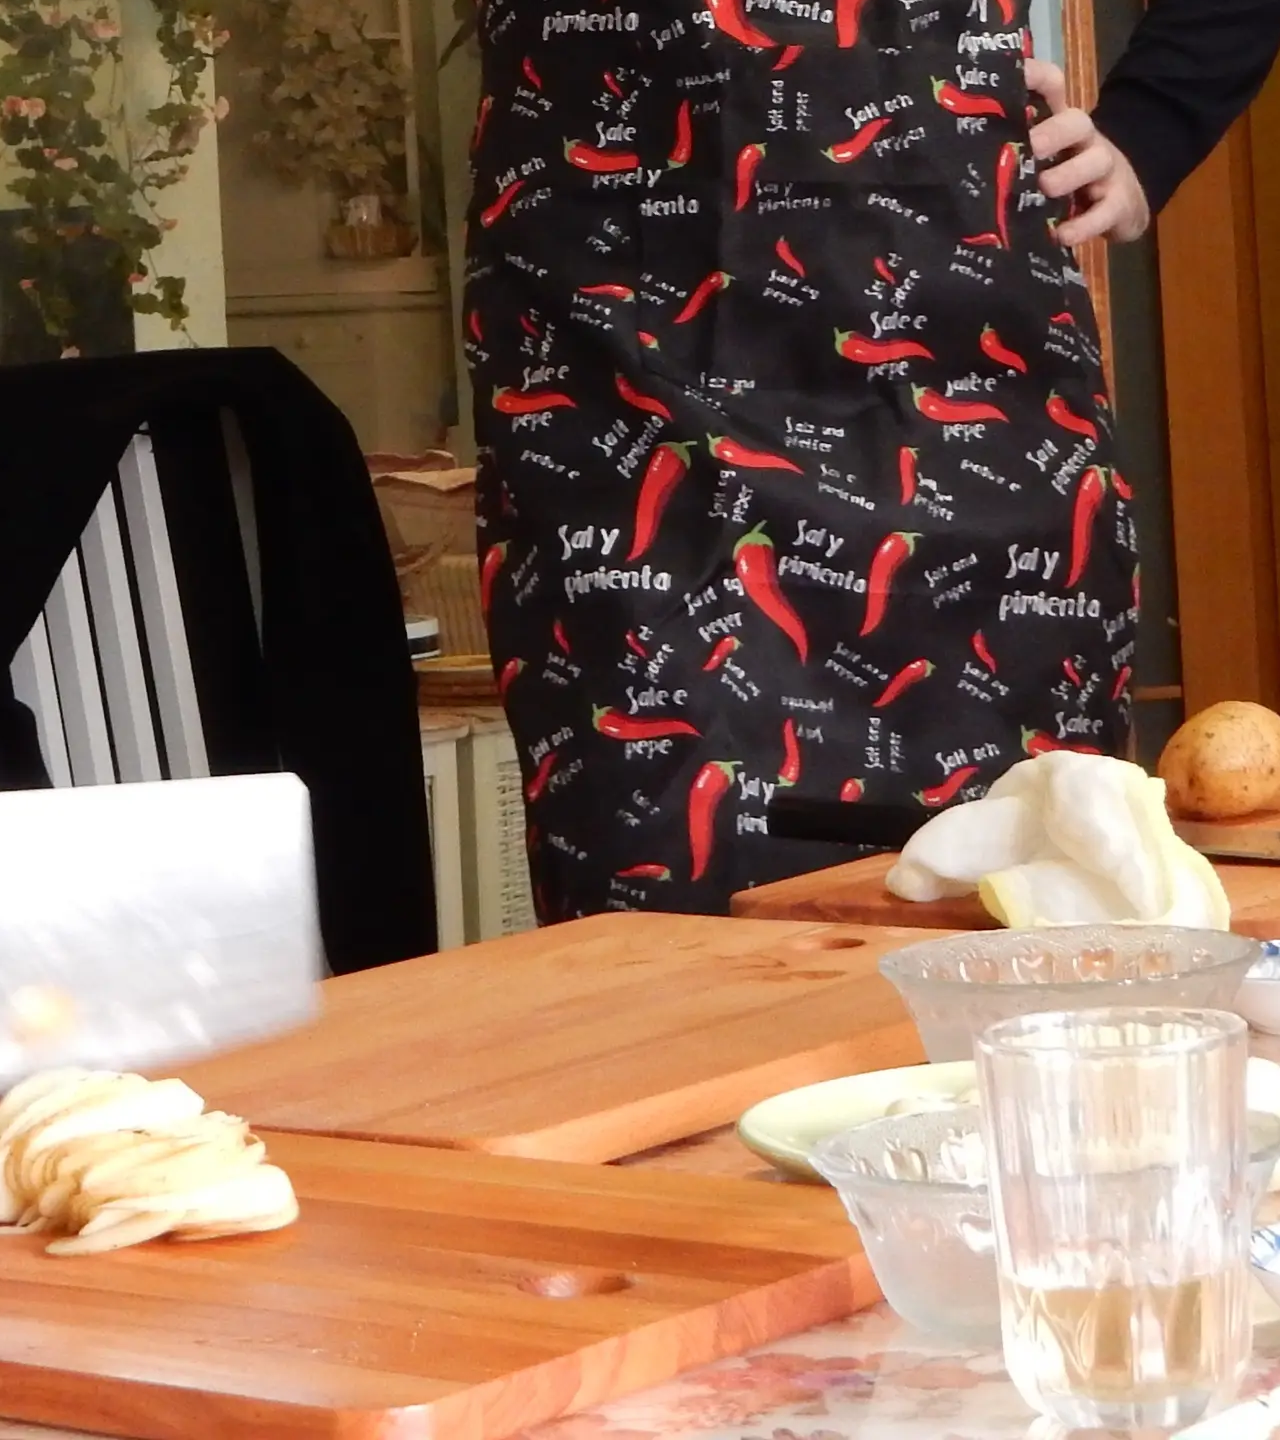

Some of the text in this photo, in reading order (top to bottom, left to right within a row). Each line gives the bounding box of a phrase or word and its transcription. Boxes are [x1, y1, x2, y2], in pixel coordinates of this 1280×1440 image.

[558, 525, 620, 561] Sal y
[825, 534, 845, 558] y
[1005, 543, 1060, 580] Sal y
[672, 688, 688, 706] e
